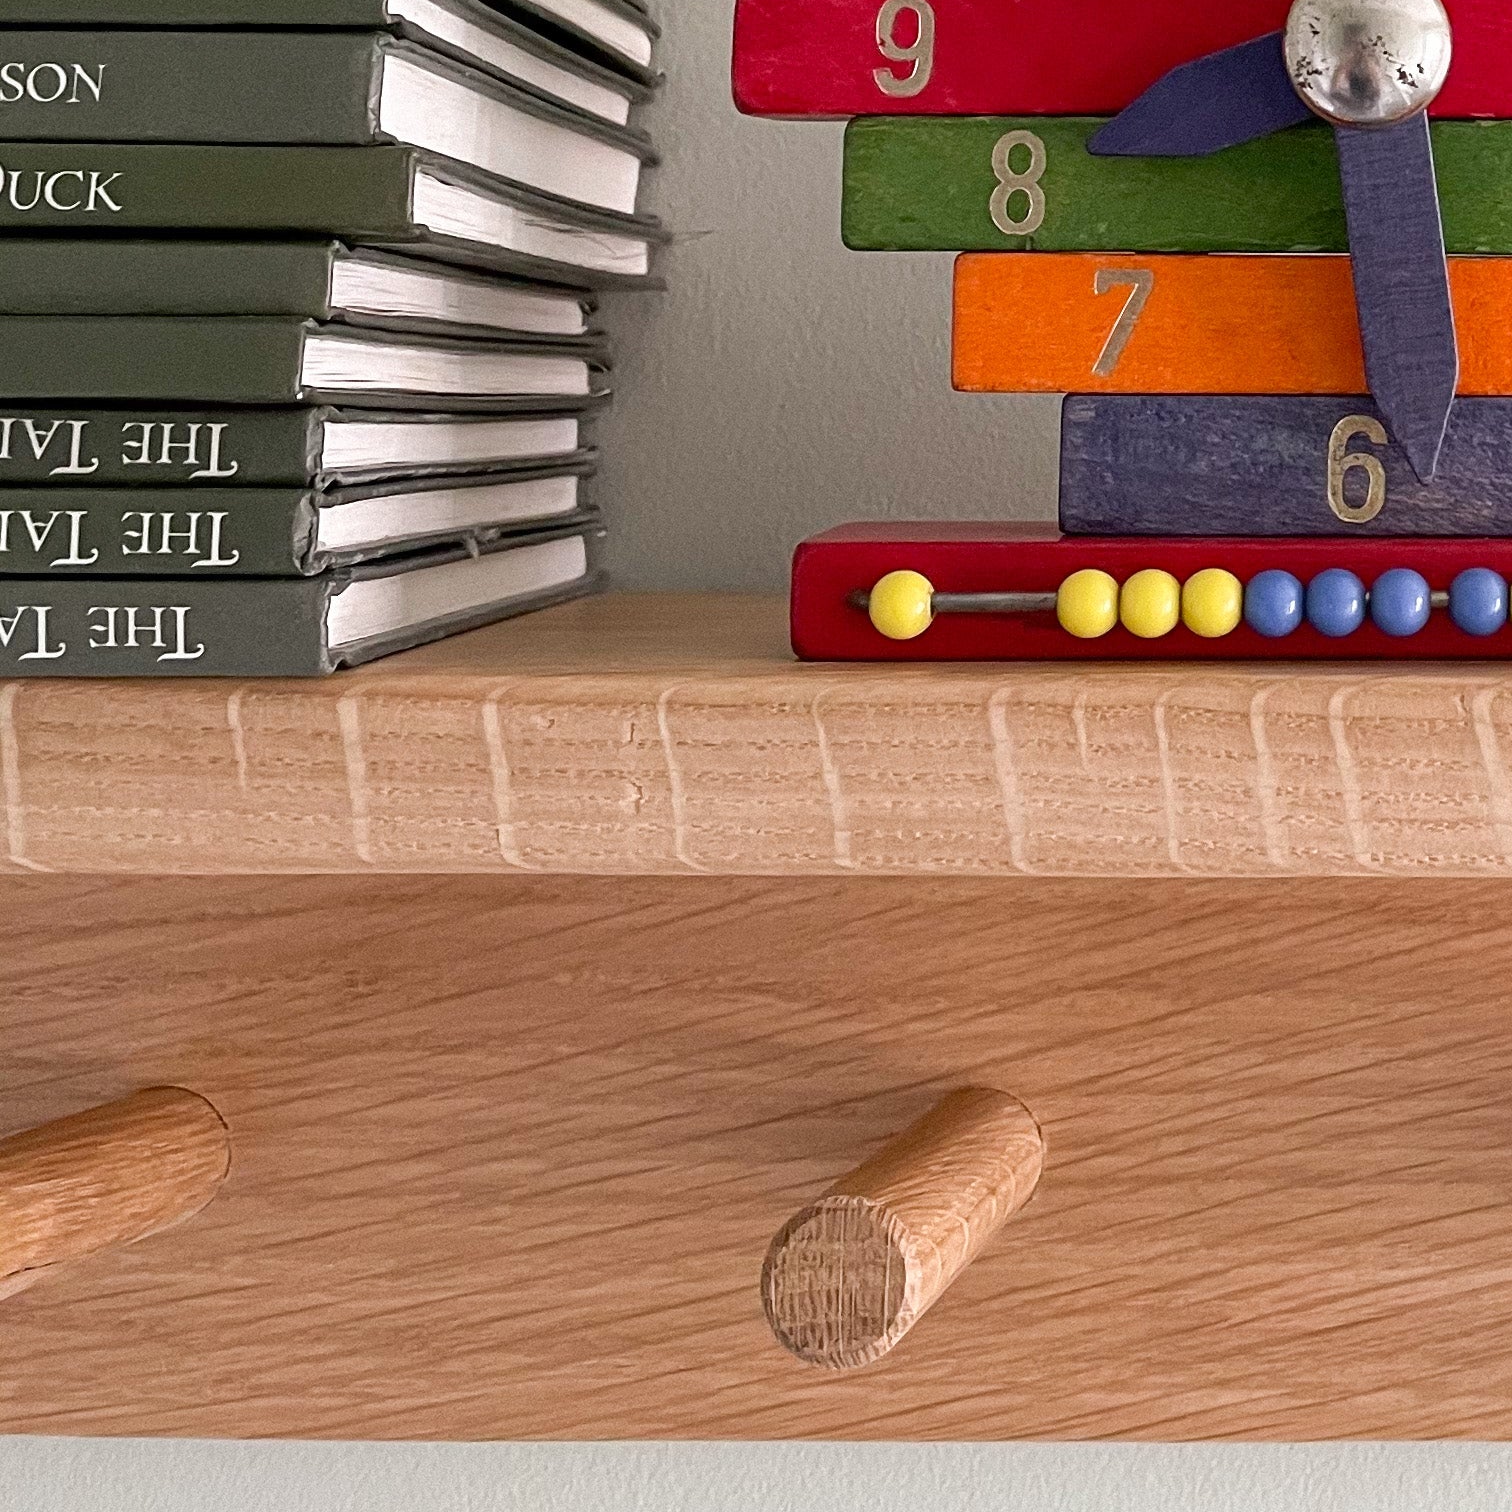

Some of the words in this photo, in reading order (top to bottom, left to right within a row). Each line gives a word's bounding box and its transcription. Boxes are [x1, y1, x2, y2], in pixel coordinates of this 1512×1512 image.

[0, 162, 125, 212] UCK
[987, 128, 1048, 238] 8
[1089, 267, 1155, 379] 7
[121, 422, 239, 479] THE
[1325, 413, 1390, 526] 6
[120, 510, 241, 568] THE
[86, 605, 206, 663] THE
